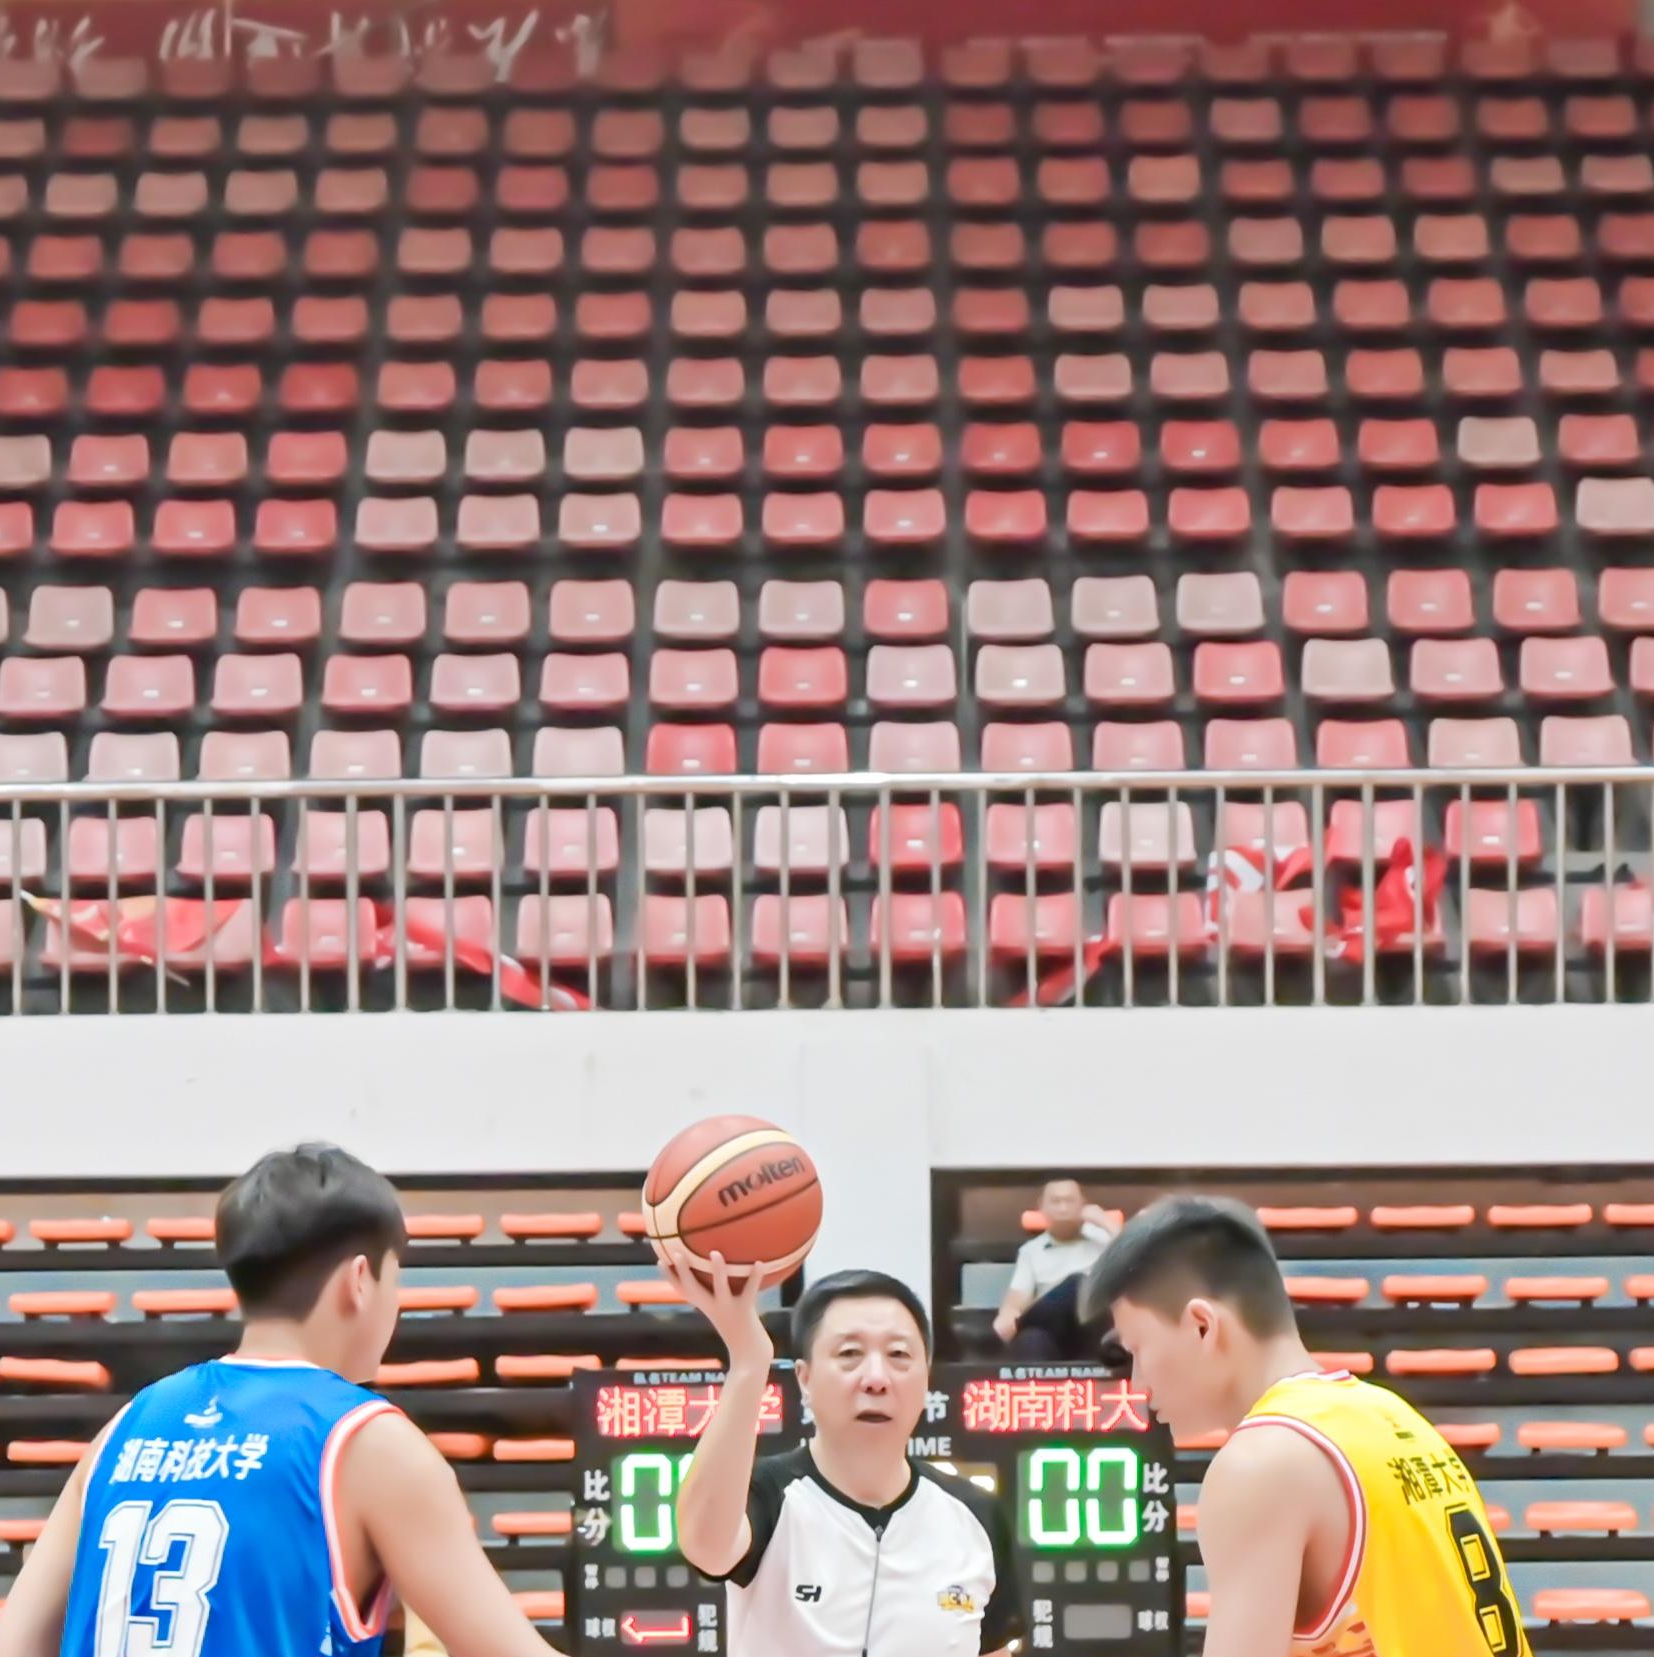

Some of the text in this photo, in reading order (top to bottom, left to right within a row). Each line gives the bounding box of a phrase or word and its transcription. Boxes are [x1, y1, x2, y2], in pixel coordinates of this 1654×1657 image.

[718, 1156, 806, 1208] molten
[963, 1379, 1149, 1432] 湖南科大
[108, 1433, 269, 1484] 湖南科技大学
[908, 1437, 952, 1457] IME
[1029, 1447, 1138, 1545] 00
